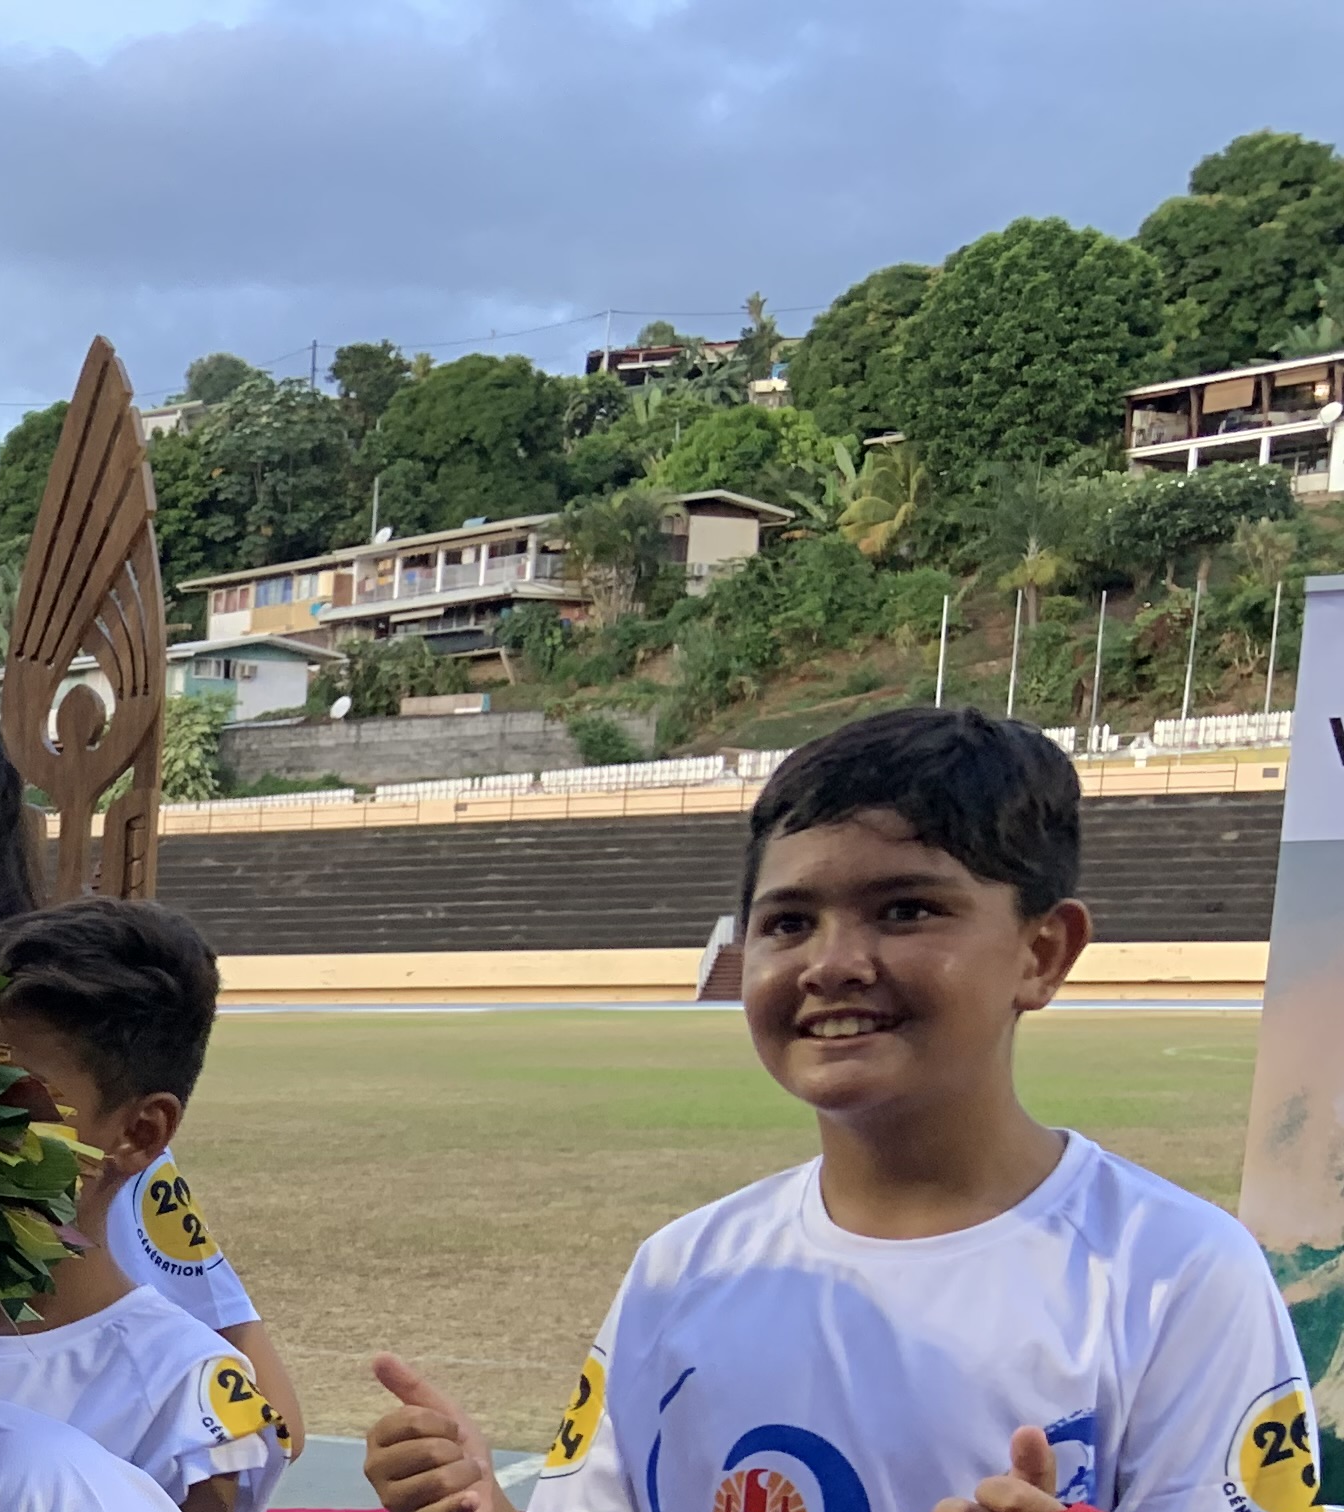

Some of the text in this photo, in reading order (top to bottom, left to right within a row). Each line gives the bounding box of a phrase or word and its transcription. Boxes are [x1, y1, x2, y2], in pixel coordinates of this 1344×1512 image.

[182, 1213, 207, 1247] 2
[136, 1228, 204, 1276] GÉNÉRATION
[218, 1368, 259, 1403] 2
[551, 1417, 584, 1459] 4
